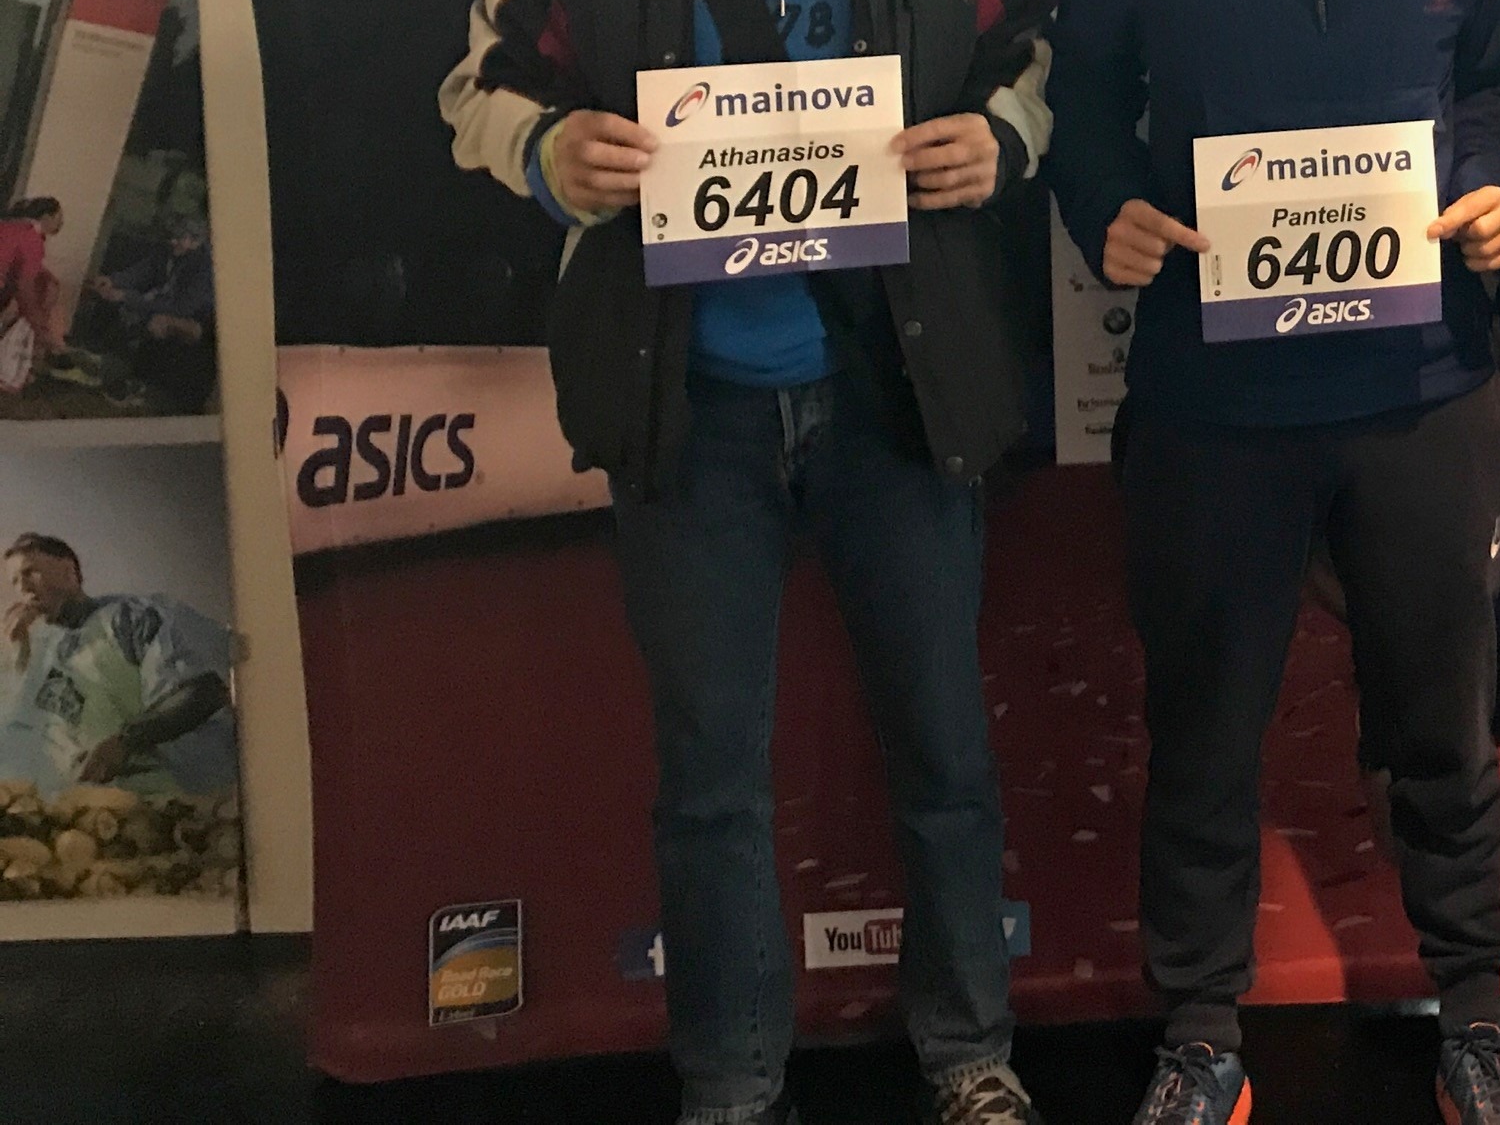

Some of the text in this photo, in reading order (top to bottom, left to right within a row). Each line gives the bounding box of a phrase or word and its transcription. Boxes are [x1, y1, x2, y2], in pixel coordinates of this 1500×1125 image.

[716, 83, 875, 117] mainova
[698, 141, 845, 170] Athanasios
[1266, 148, 1412, 181] mainova
[692, 164, 860, 232] 6404
[1271, 202, 1368, 228] Pantelis
[760, 237, 828, 266] asics
[1247, 226, 1401, 291] 6400
[1306, 298, 1371, 325] asics
[297, 413, 476, 508] asics
[439, 909, 500, 932] IAAF
